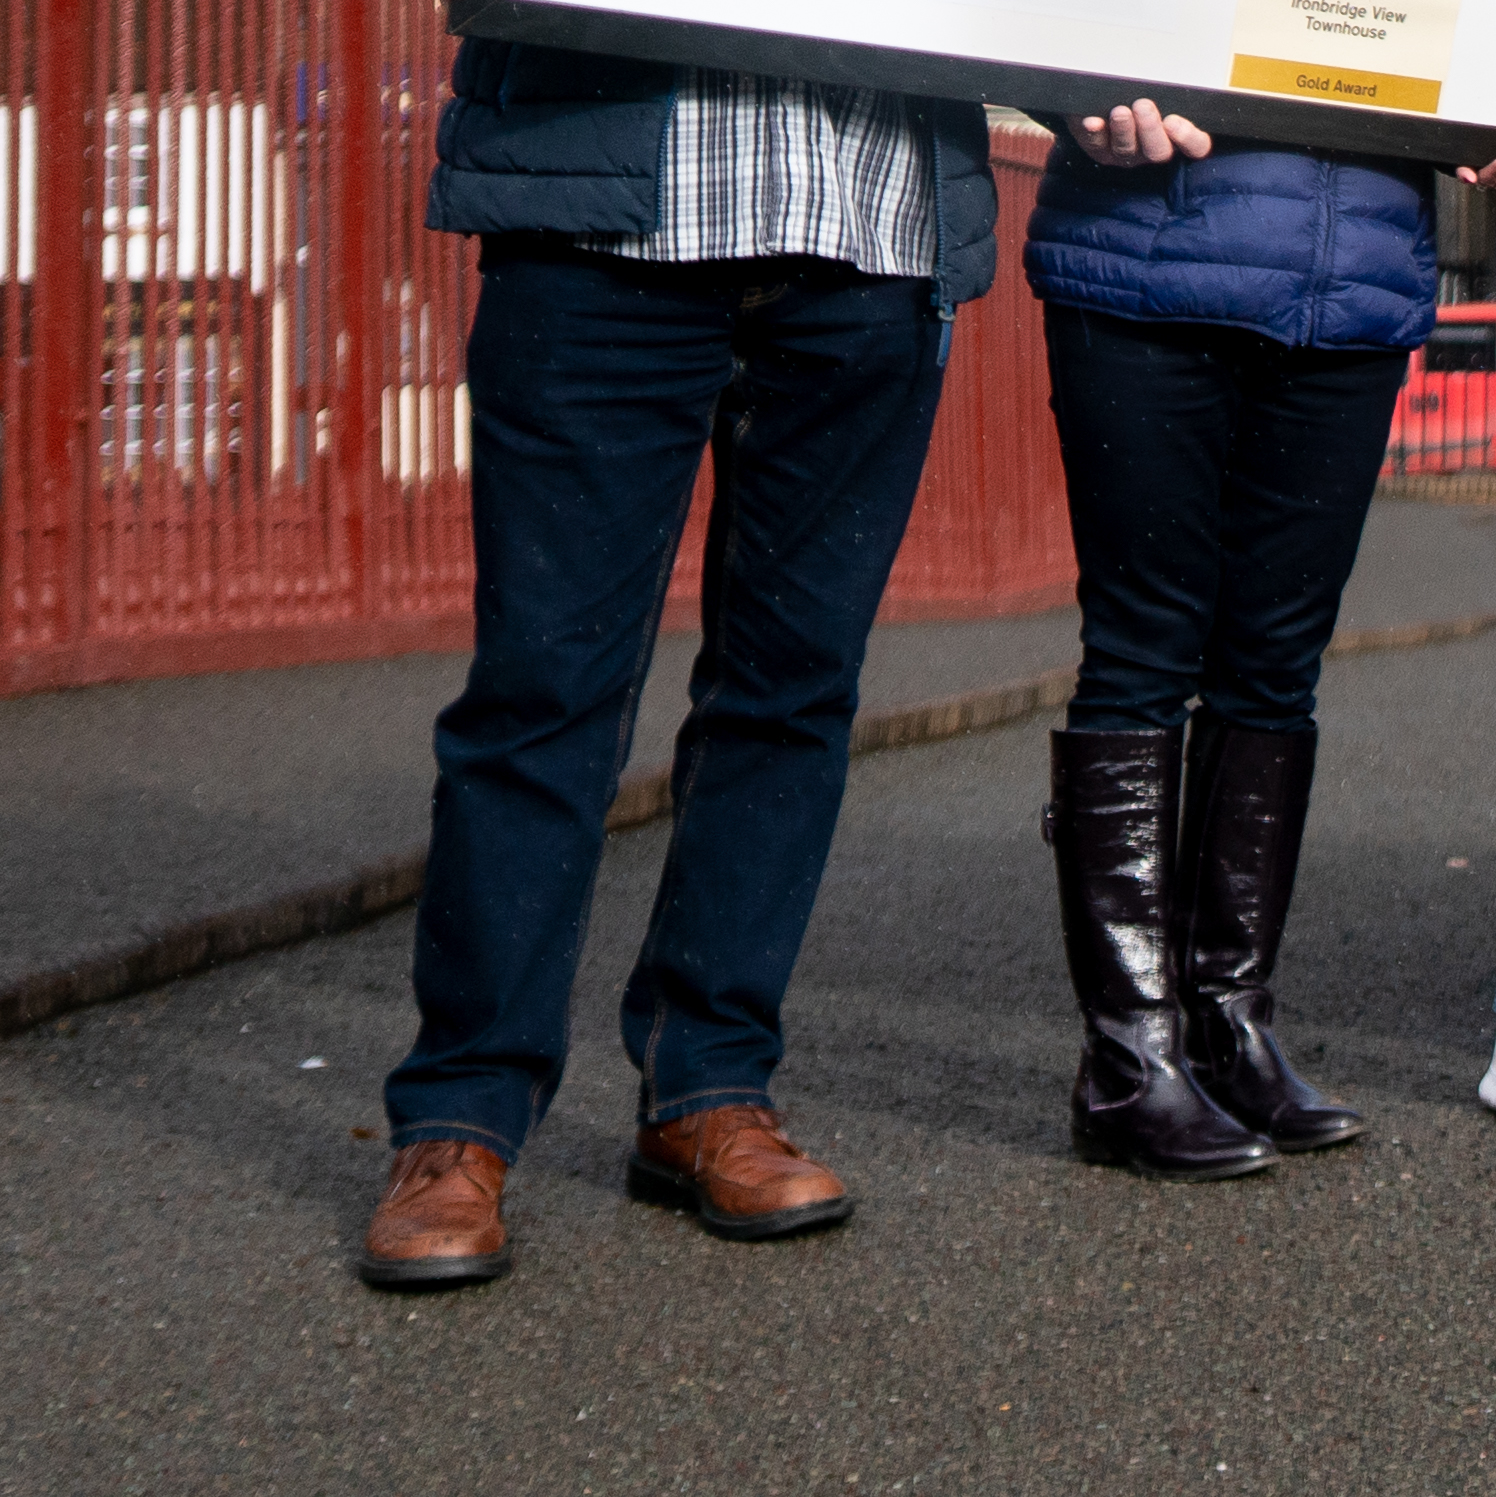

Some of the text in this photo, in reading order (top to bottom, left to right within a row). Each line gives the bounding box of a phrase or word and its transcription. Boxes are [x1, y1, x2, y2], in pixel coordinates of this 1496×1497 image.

[1372, 5, 1407, 24] View
[1305, 15, 1387, 40] Townhouse
[1296, 74, 1377, 98] Gold Award
